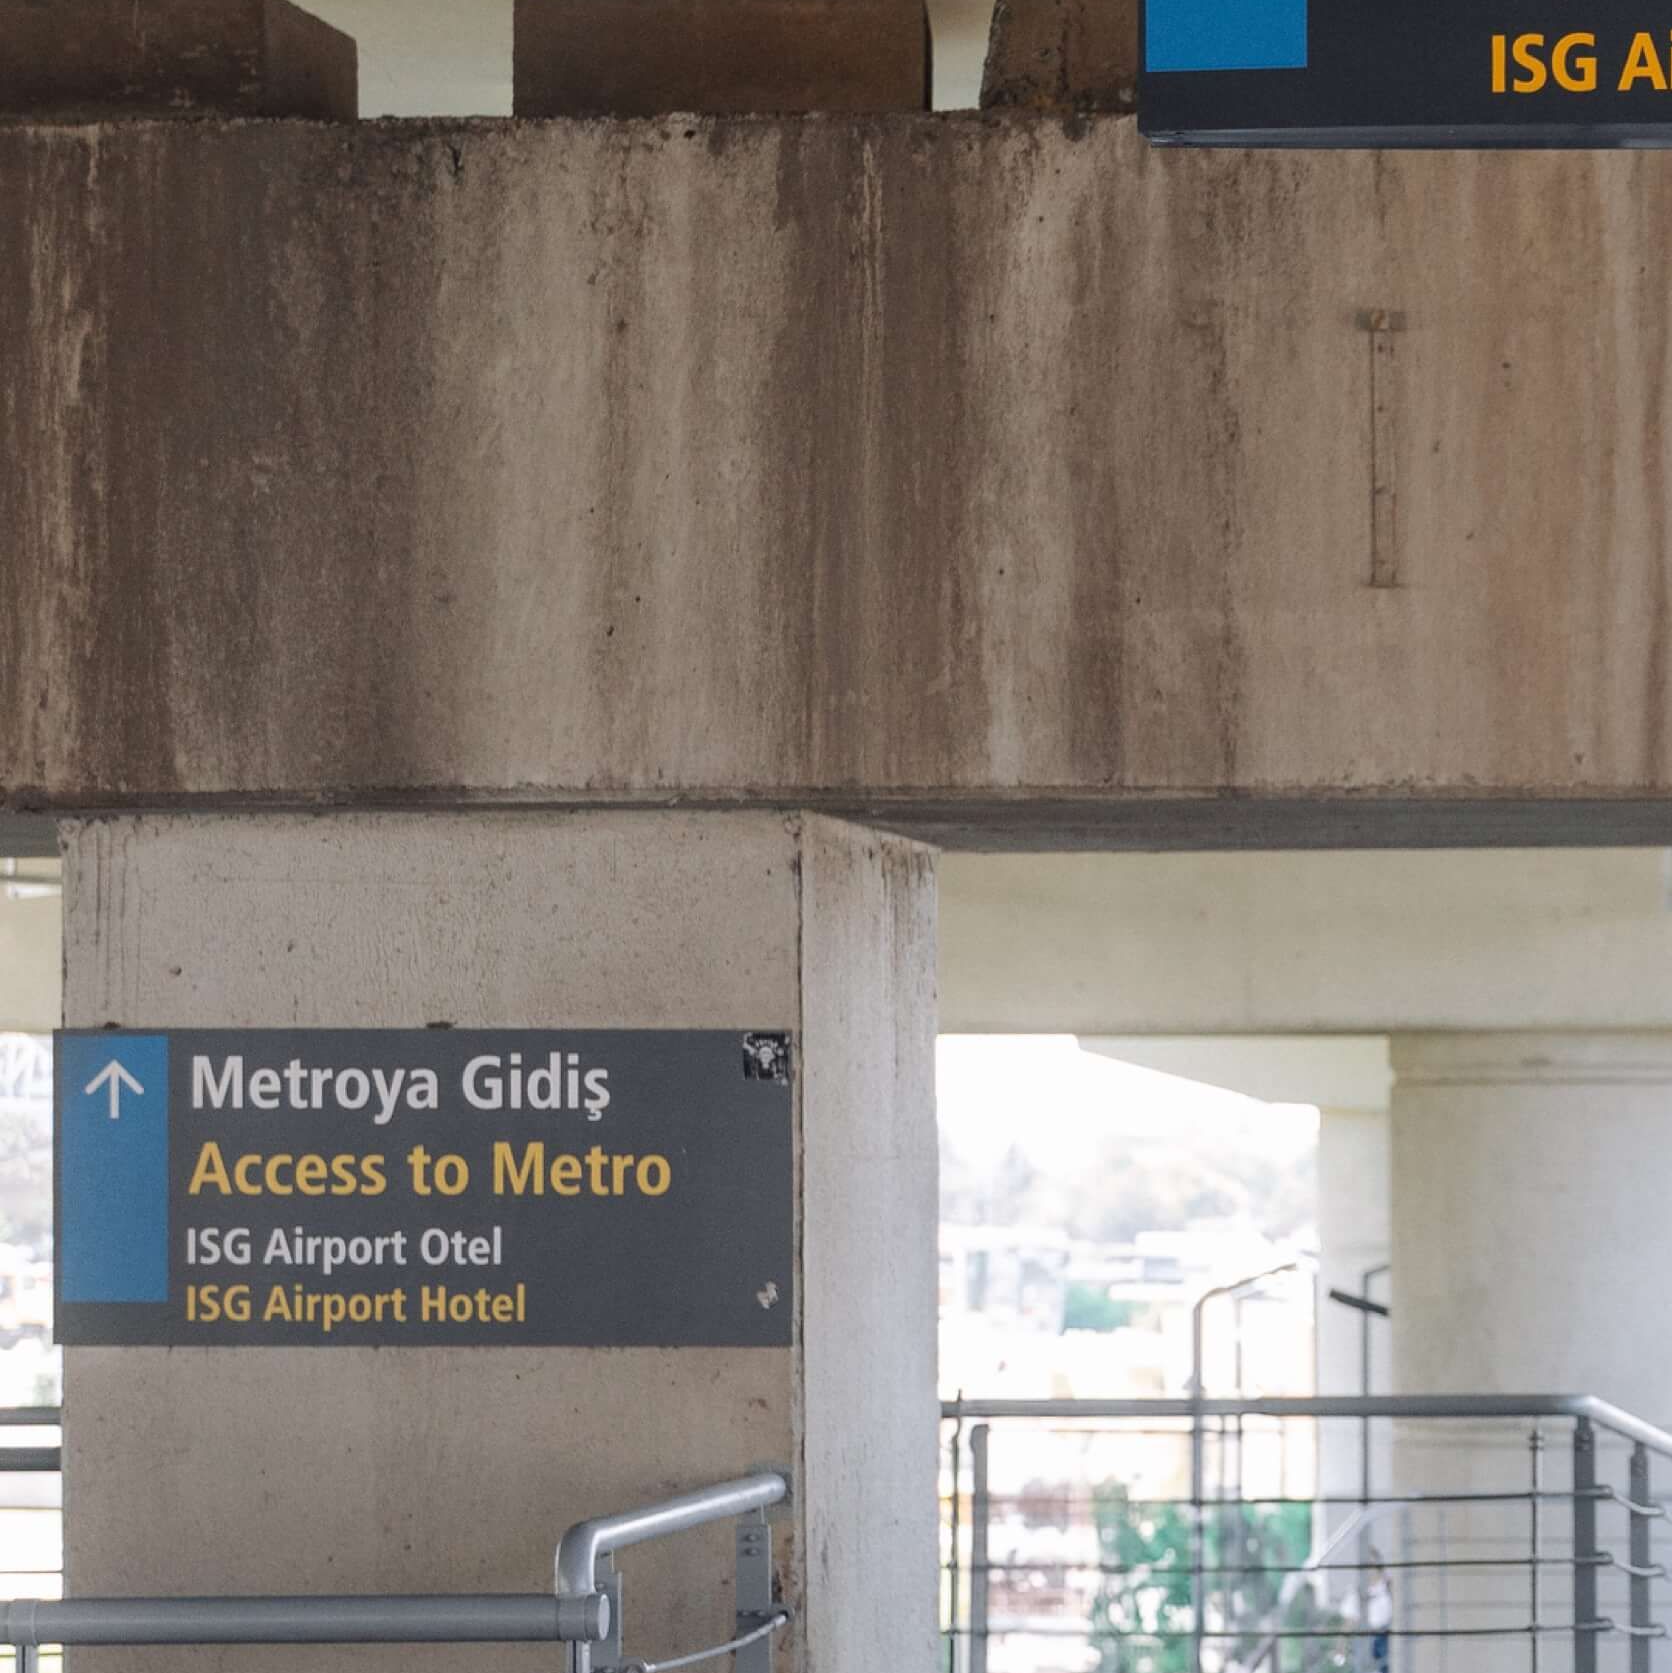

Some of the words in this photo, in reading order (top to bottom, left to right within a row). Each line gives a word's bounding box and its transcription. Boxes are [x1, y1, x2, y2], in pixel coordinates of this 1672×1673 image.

[1491, 32, 1597, 93] ISG
[192, 1055, 438, 1125] Metroya
[461, 1051, 611, 1122] Gidiş
[188, 1141, 387, 1195] Access
[407, 1145, 469, 1195] to
[493, 1141, 671, 1196] Metro
[187, 1227, 251, 1265] ISG
[263, 1226, 407, 1275] Airport
[420, 1225, 502, 1266] Otel
[187, 1284, 251, 1322] ISG
[263, 1284, 407, 1332] Airport
[421, 1283, 525, 1322] Hotel
